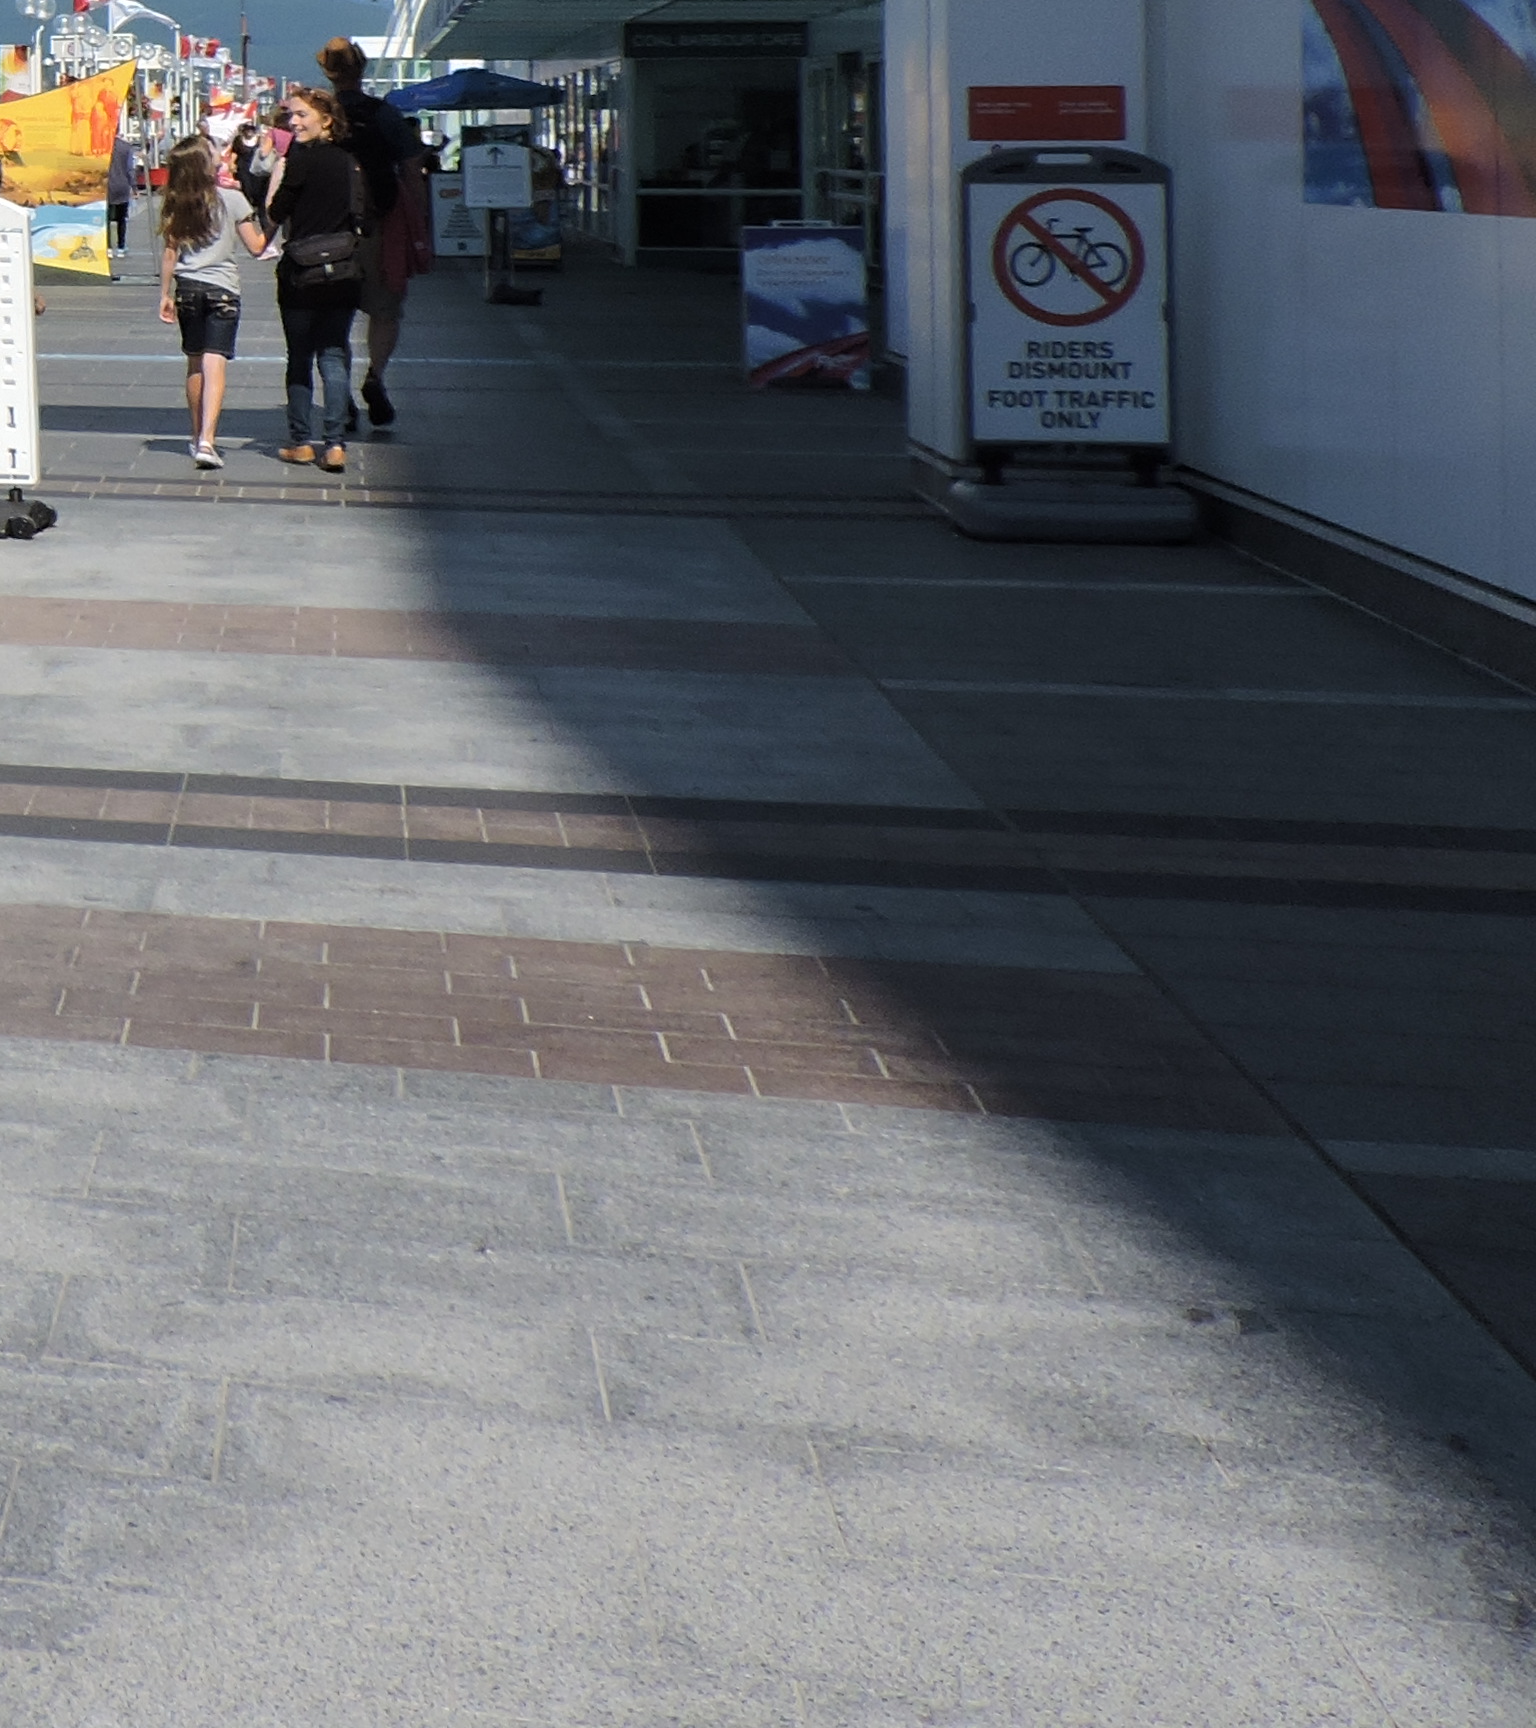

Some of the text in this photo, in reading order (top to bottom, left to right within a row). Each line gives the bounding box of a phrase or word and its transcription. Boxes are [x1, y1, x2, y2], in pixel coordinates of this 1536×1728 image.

[1027, 341, 1114, 359] RIDERS
[1007, 361, 1133, 380] DISMOUNT
[987, 390, 1156, 409] FOOT TRAFFIC
[1041, 411, 1101, 429] ONLY
